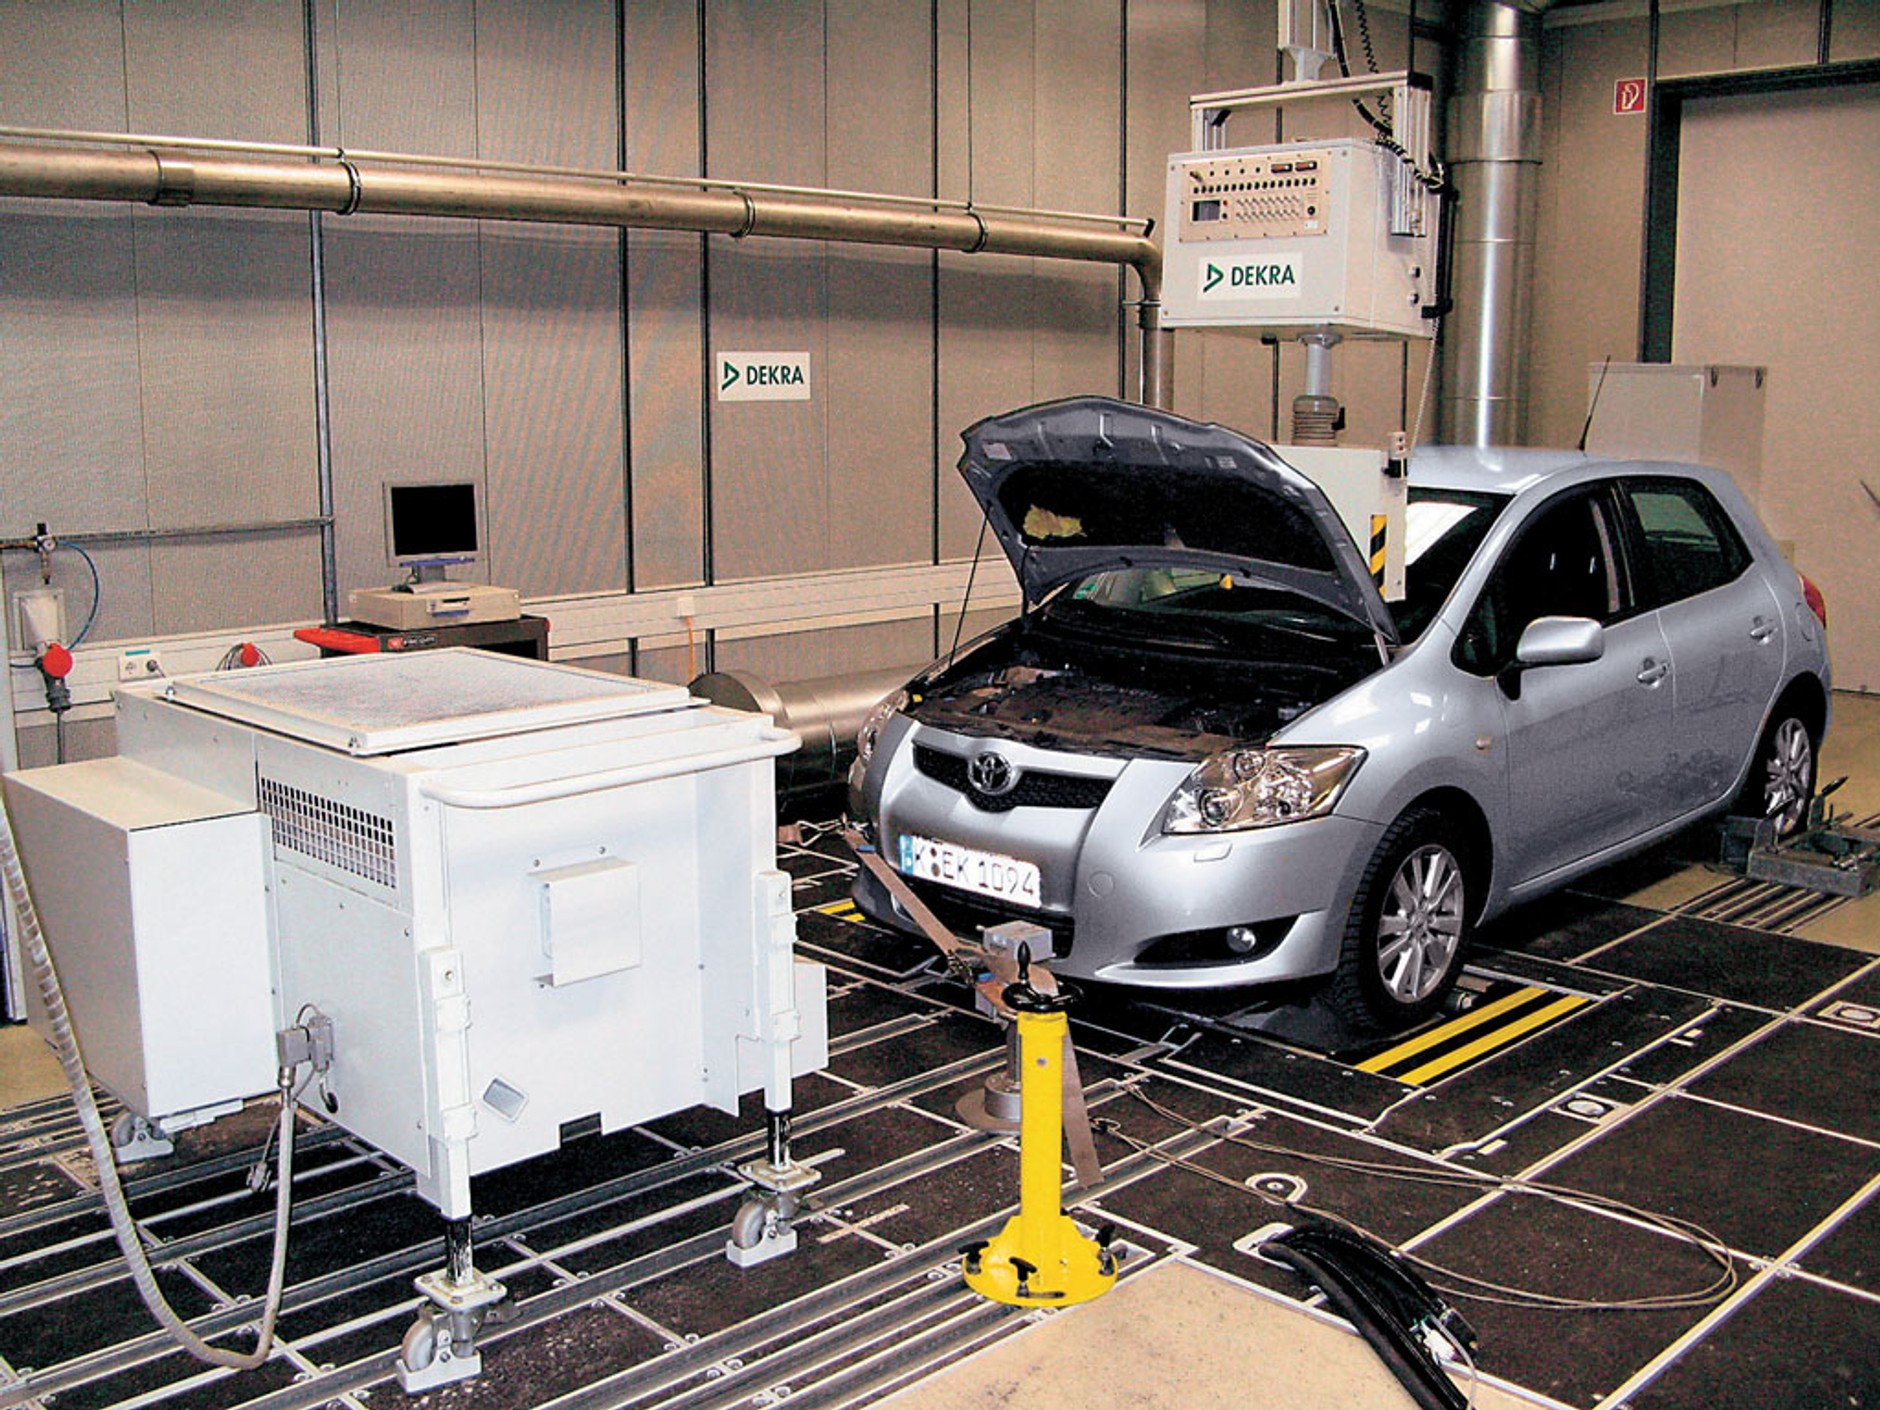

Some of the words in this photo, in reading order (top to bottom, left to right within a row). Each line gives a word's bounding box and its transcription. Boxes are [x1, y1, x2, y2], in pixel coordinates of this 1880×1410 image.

[1231, 264, 1296, 286] DEKRA
[746, 365, 804, 385] DEKRA
[942, 850, 970, 884] EK
[978, 861, 1034, 895] 1094
